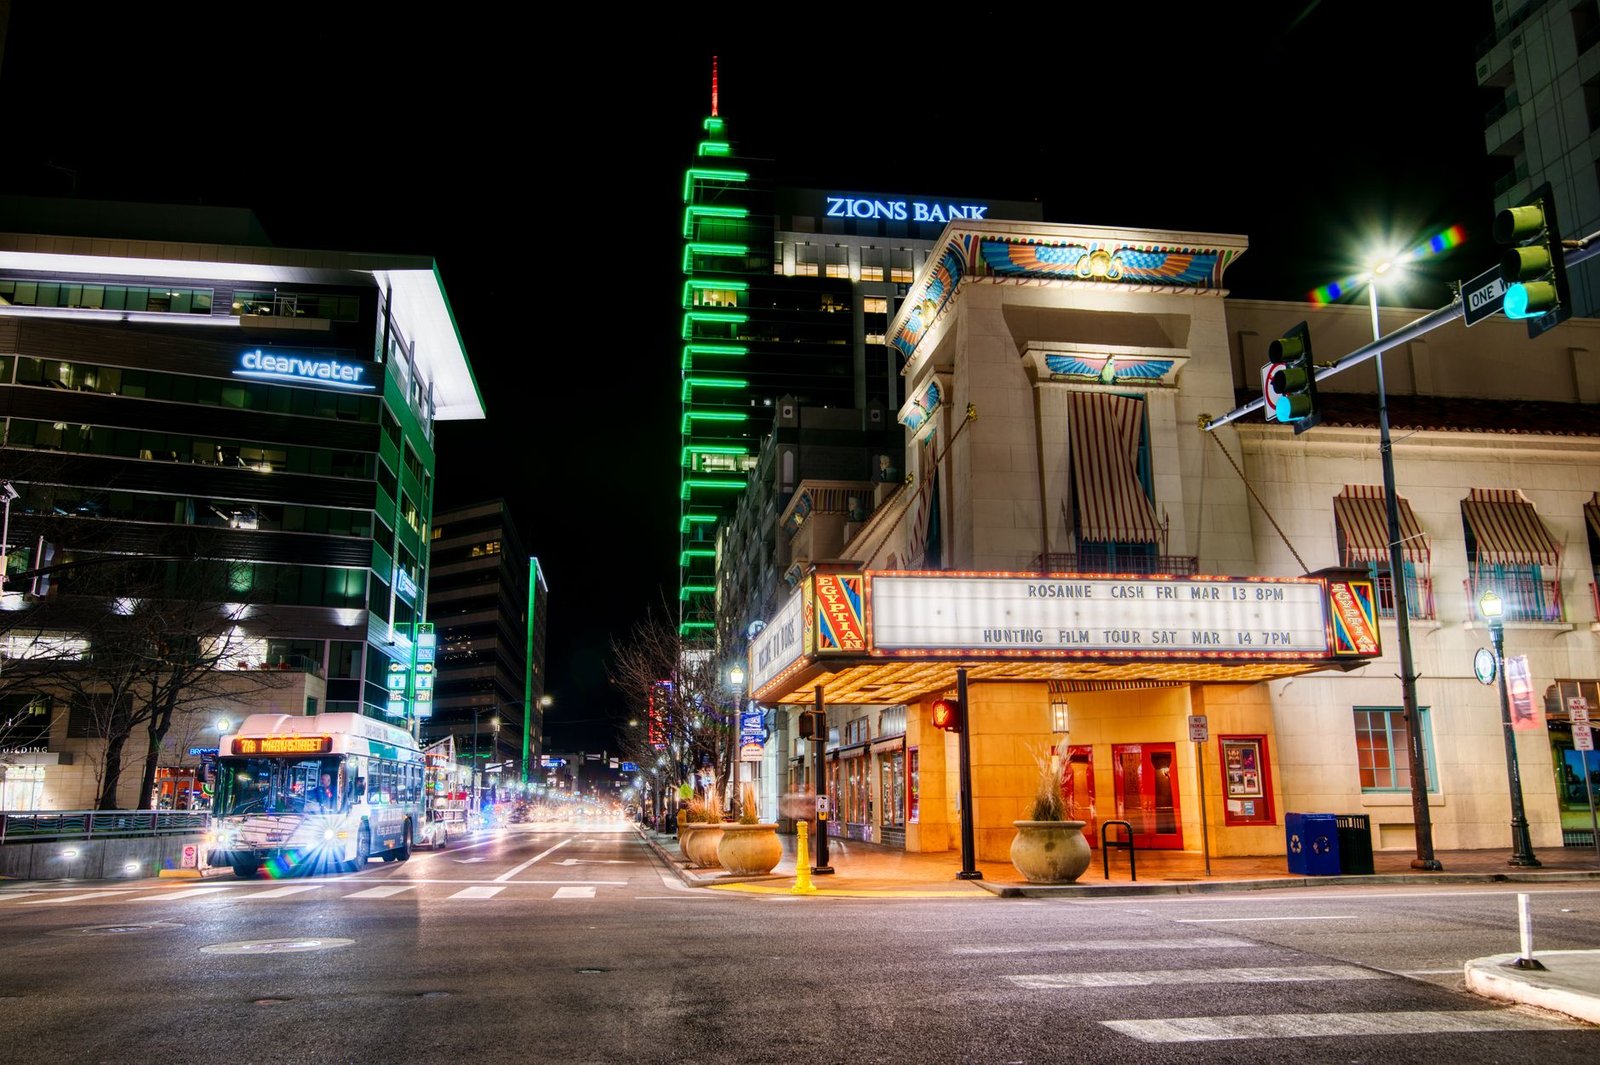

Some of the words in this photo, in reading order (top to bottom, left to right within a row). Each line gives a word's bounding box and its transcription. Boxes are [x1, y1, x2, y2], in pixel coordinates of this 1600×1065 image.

[827, 197, 908, 221] ZIONS
[913, 203, 988, 223] BANK
[1472, 285, 1495, 308] ONE
[242, 350, 364, 382] clearwater
[1028, 584, 1092, 598] ROSANNE
[1111, 586, 1144, 599] CASH
[1156, 586, 1178, 599] FRI
[1191, 586, 1220, 600] MAR
[1232, 587, 1247, 600] 13
[1256, 588, 1284, 601] 8PM
[818, 577, 863, 650] EGYPTIAN
[1331, 583, 1377, 653] EGYPTIAN
[984, 629, 1044, 643] HUNTING
[1059, 630, 1090, 643] FILM
[1103, 630, 1141, 644] TOUR
[1152, 631, 1177, 644] SAT
[1192, 631, 1220, 644] MAR
[1238, 632, 1252, 645] 14
[1262, 632, 1291, 645] 7PM
